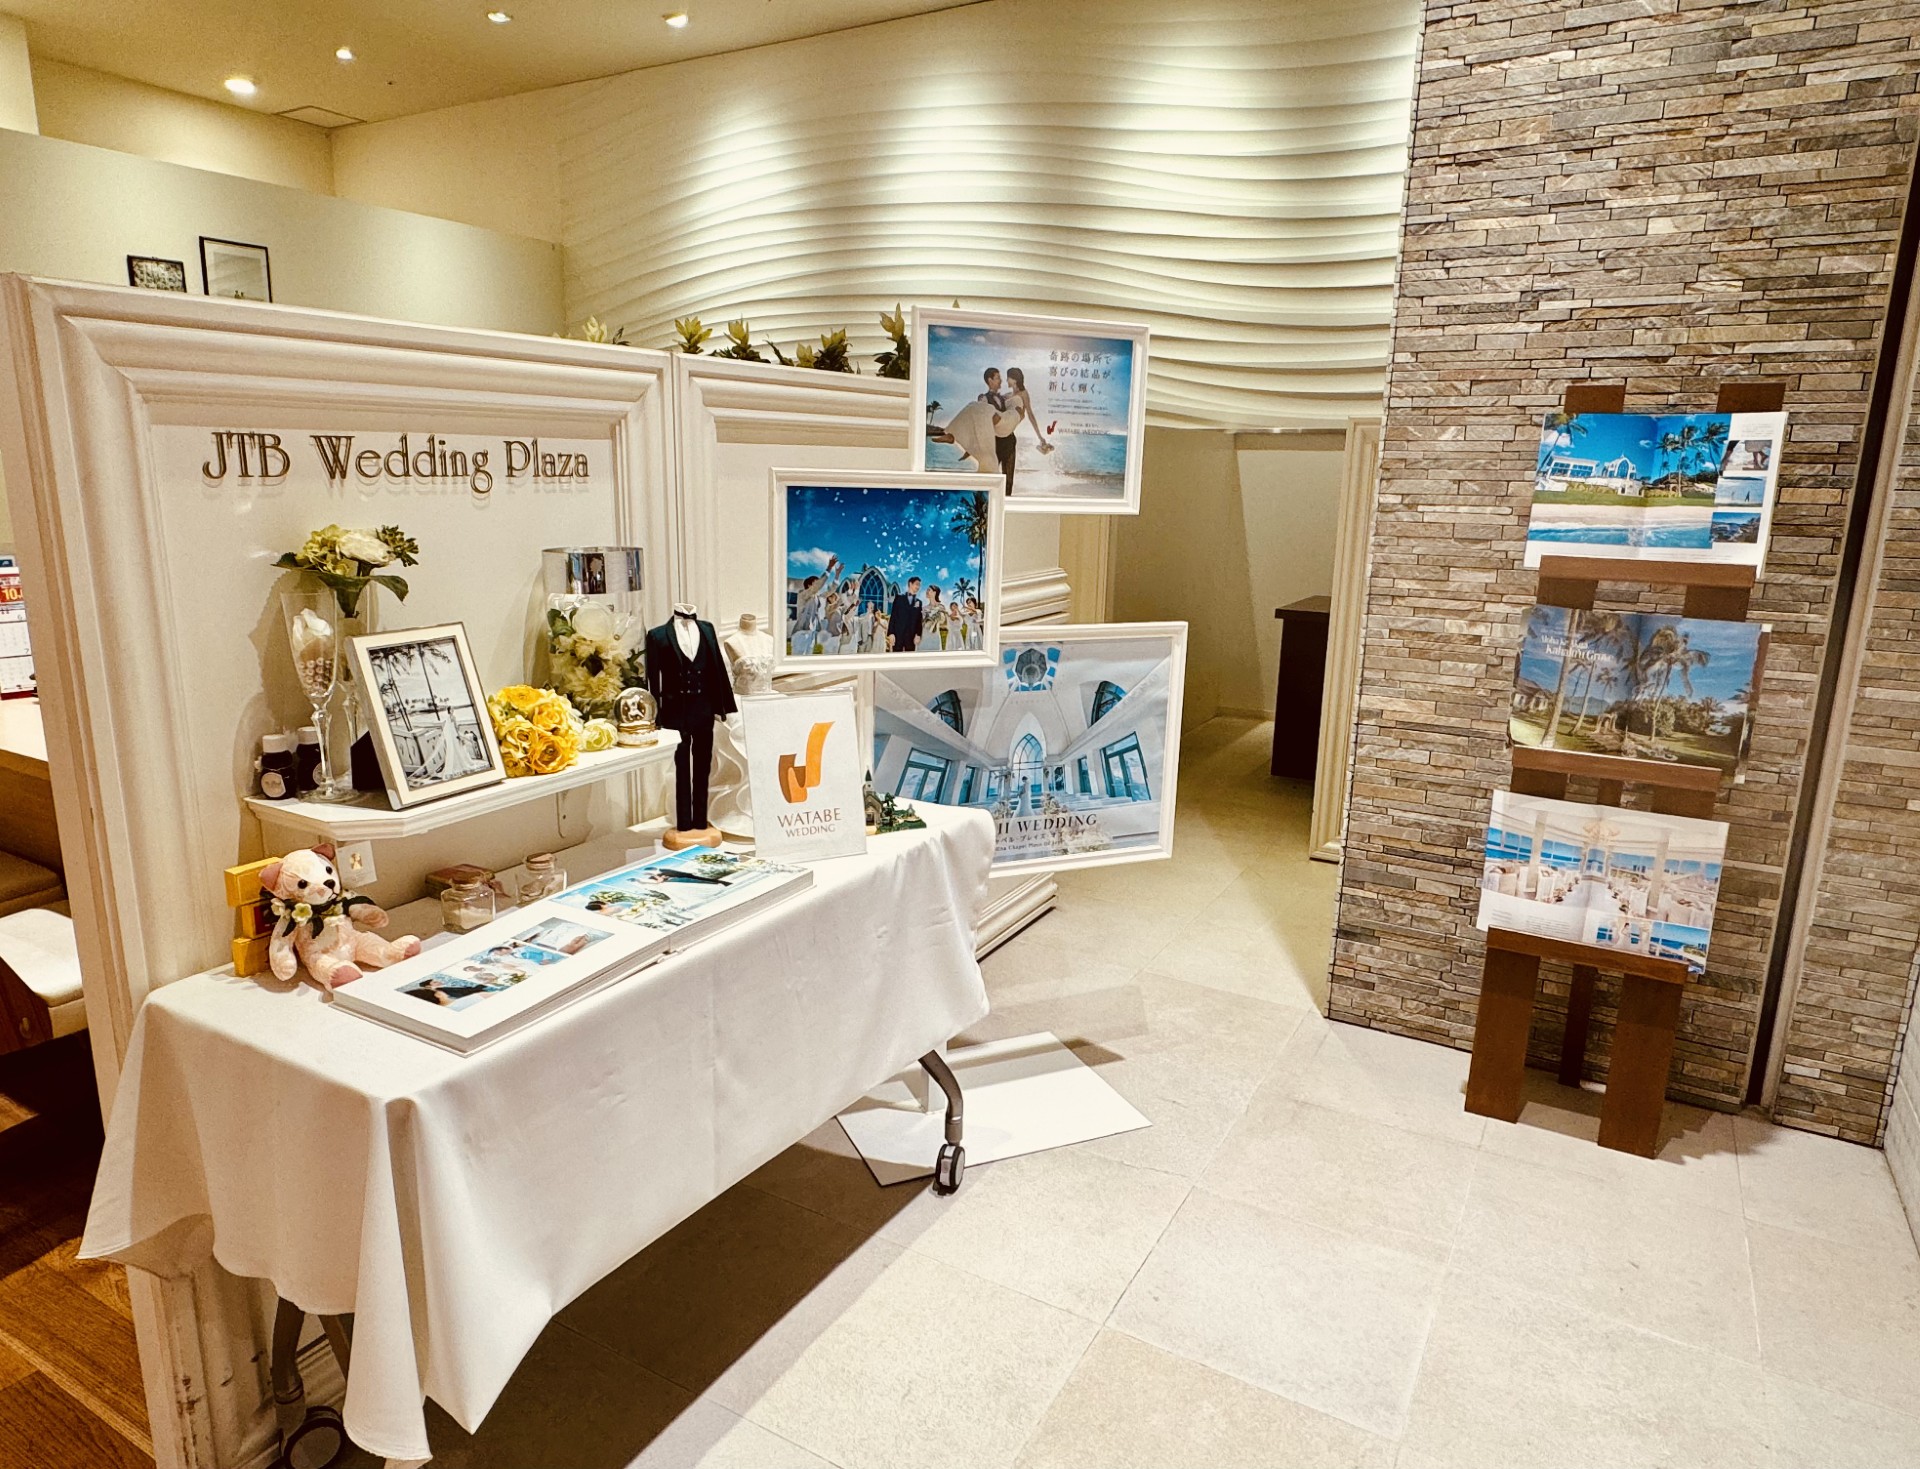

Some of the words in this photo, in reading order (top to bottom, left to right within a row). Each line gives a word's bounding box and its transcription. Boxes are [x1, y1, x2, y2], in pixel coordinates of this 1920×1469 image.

[202, 431, 291, 480] JTB
[310, 432, 493, 494] Wedding
[503, 437, 590, 479] Plaza
[777, 808, 842, 828] WATABE
[1017, 814, 1097, 832] WEDDING
[785, 824, 836, 838] WEDDING
